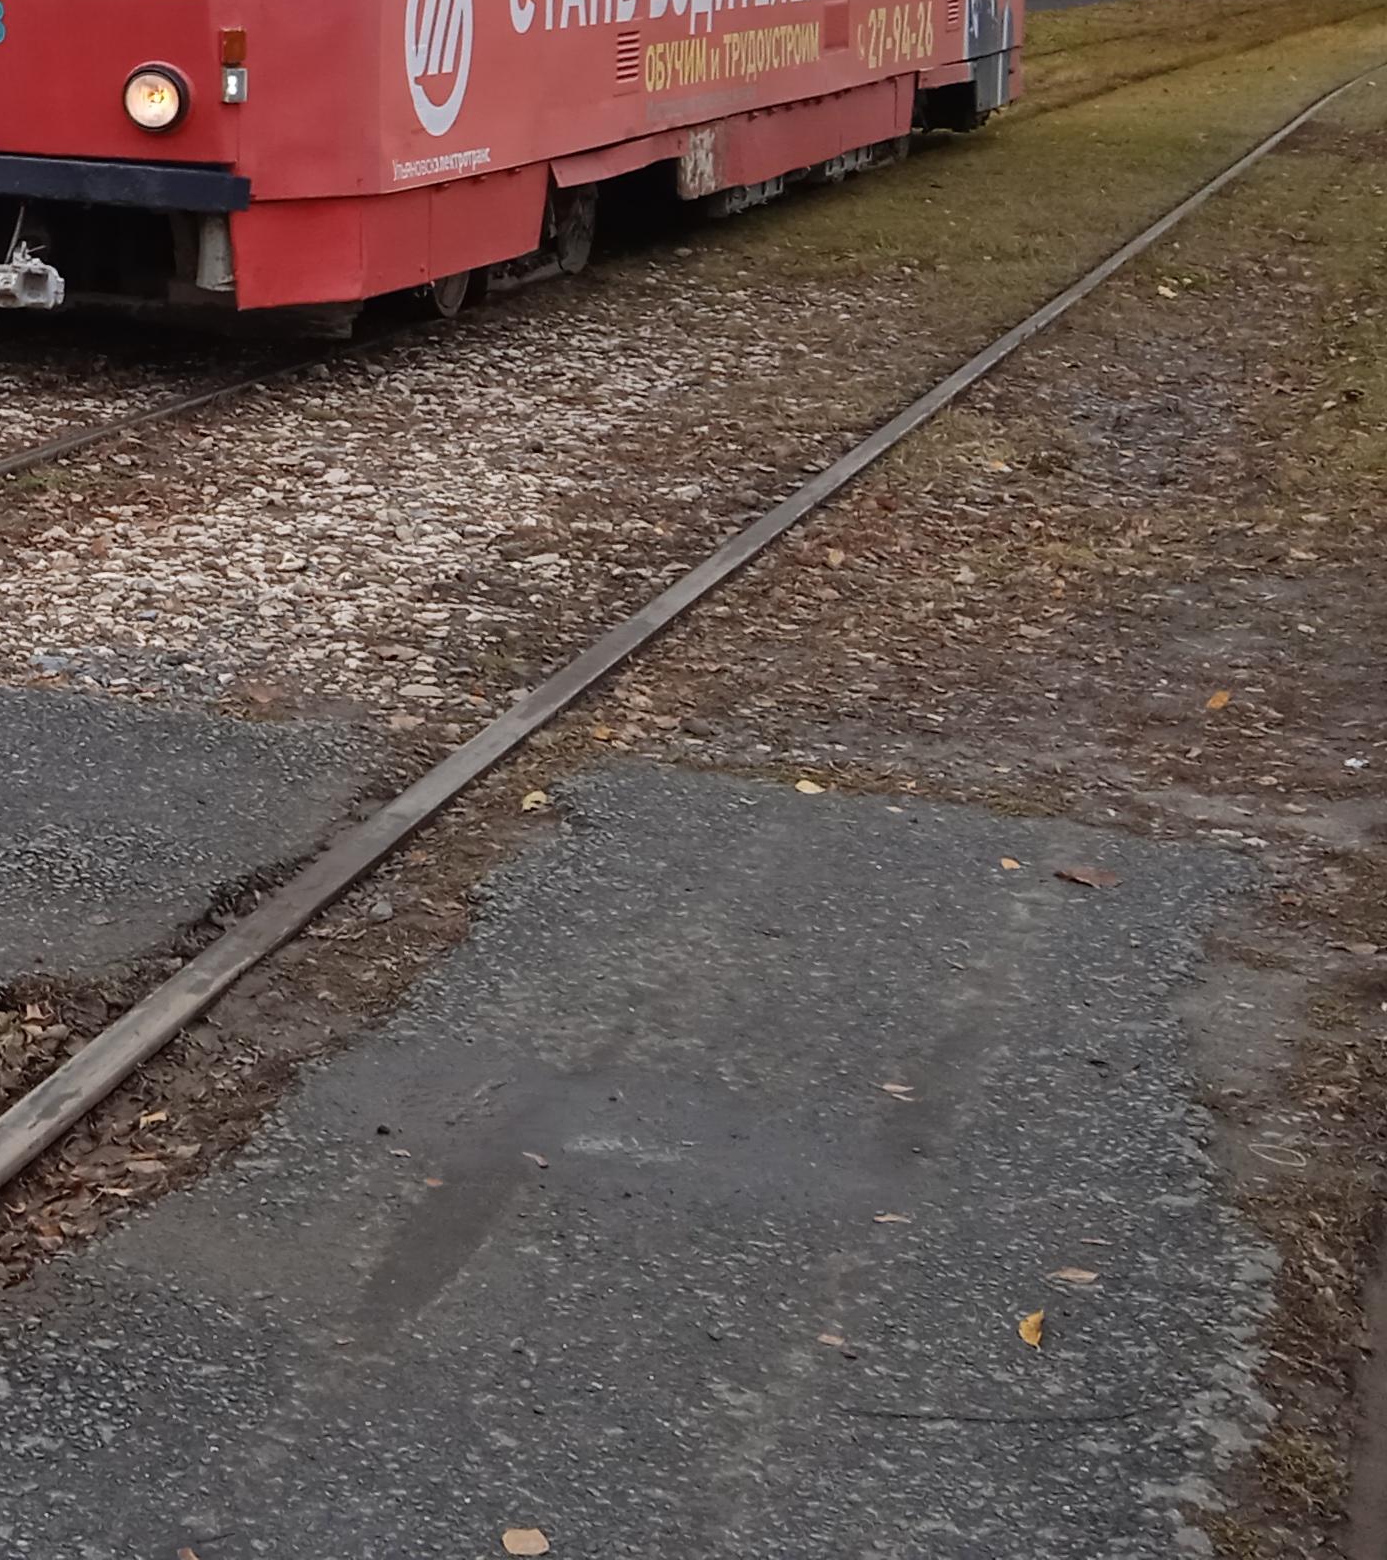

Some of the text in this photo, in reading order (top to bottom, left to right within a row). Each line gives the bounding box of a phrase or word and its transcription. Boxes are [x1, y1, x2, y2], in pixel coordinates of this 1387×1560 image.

[645, 39, 707, 92] ОБУЧИМ
[723, 21, 819, 83] ТРУДОУСТРОИМ
[868, 1, 934, 69] 27-94-26
